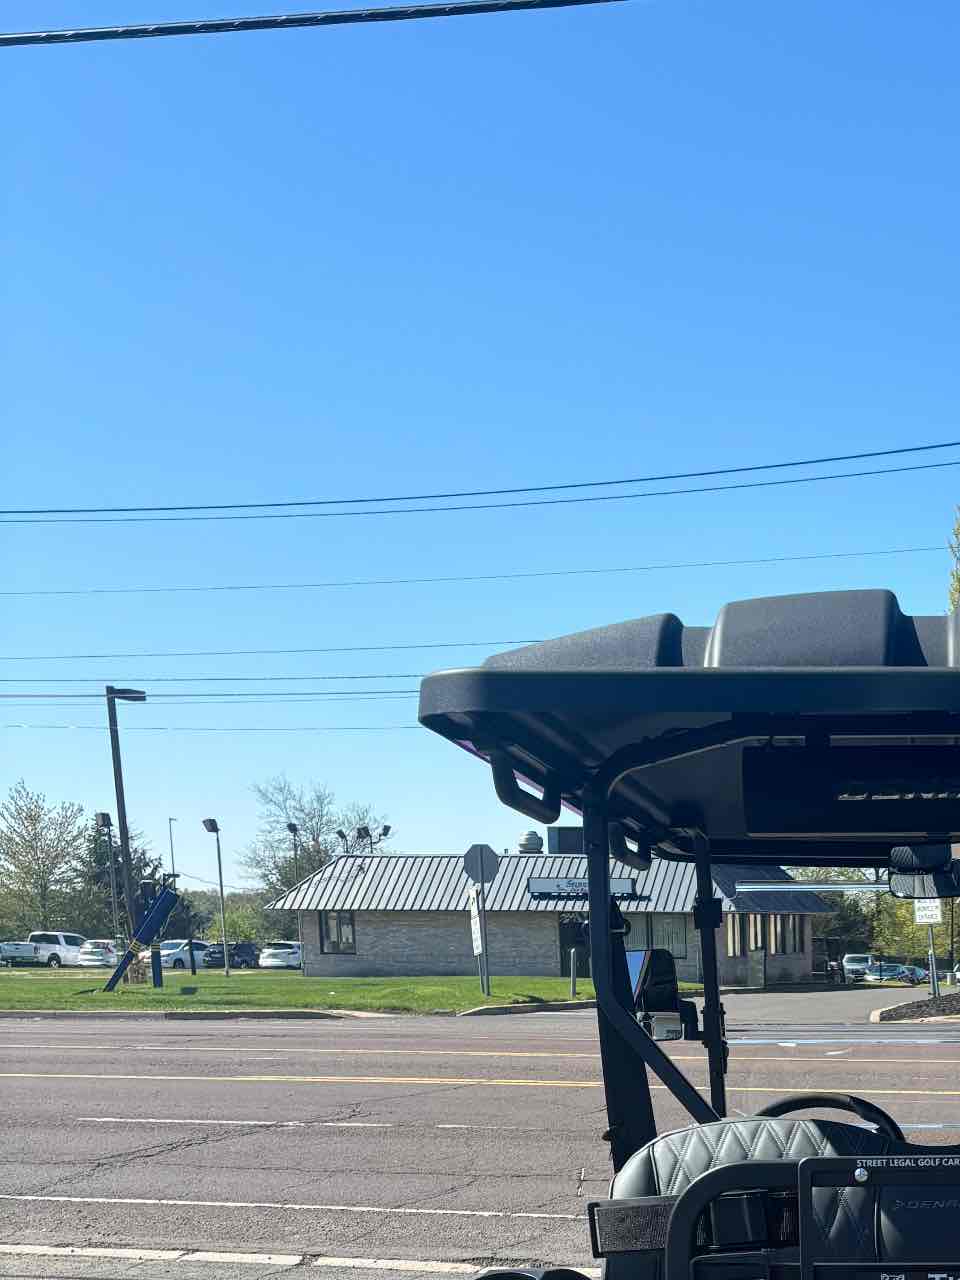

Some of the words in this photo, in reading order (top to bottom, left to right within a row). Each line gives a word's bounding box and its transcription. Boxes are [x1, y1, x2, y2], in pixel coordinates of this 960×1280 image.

[856, 1159, 888, 1168] STREET
[890, 1159, 916, 1168] LEGAL
[918, 1158, 940, 1167] GOLF
